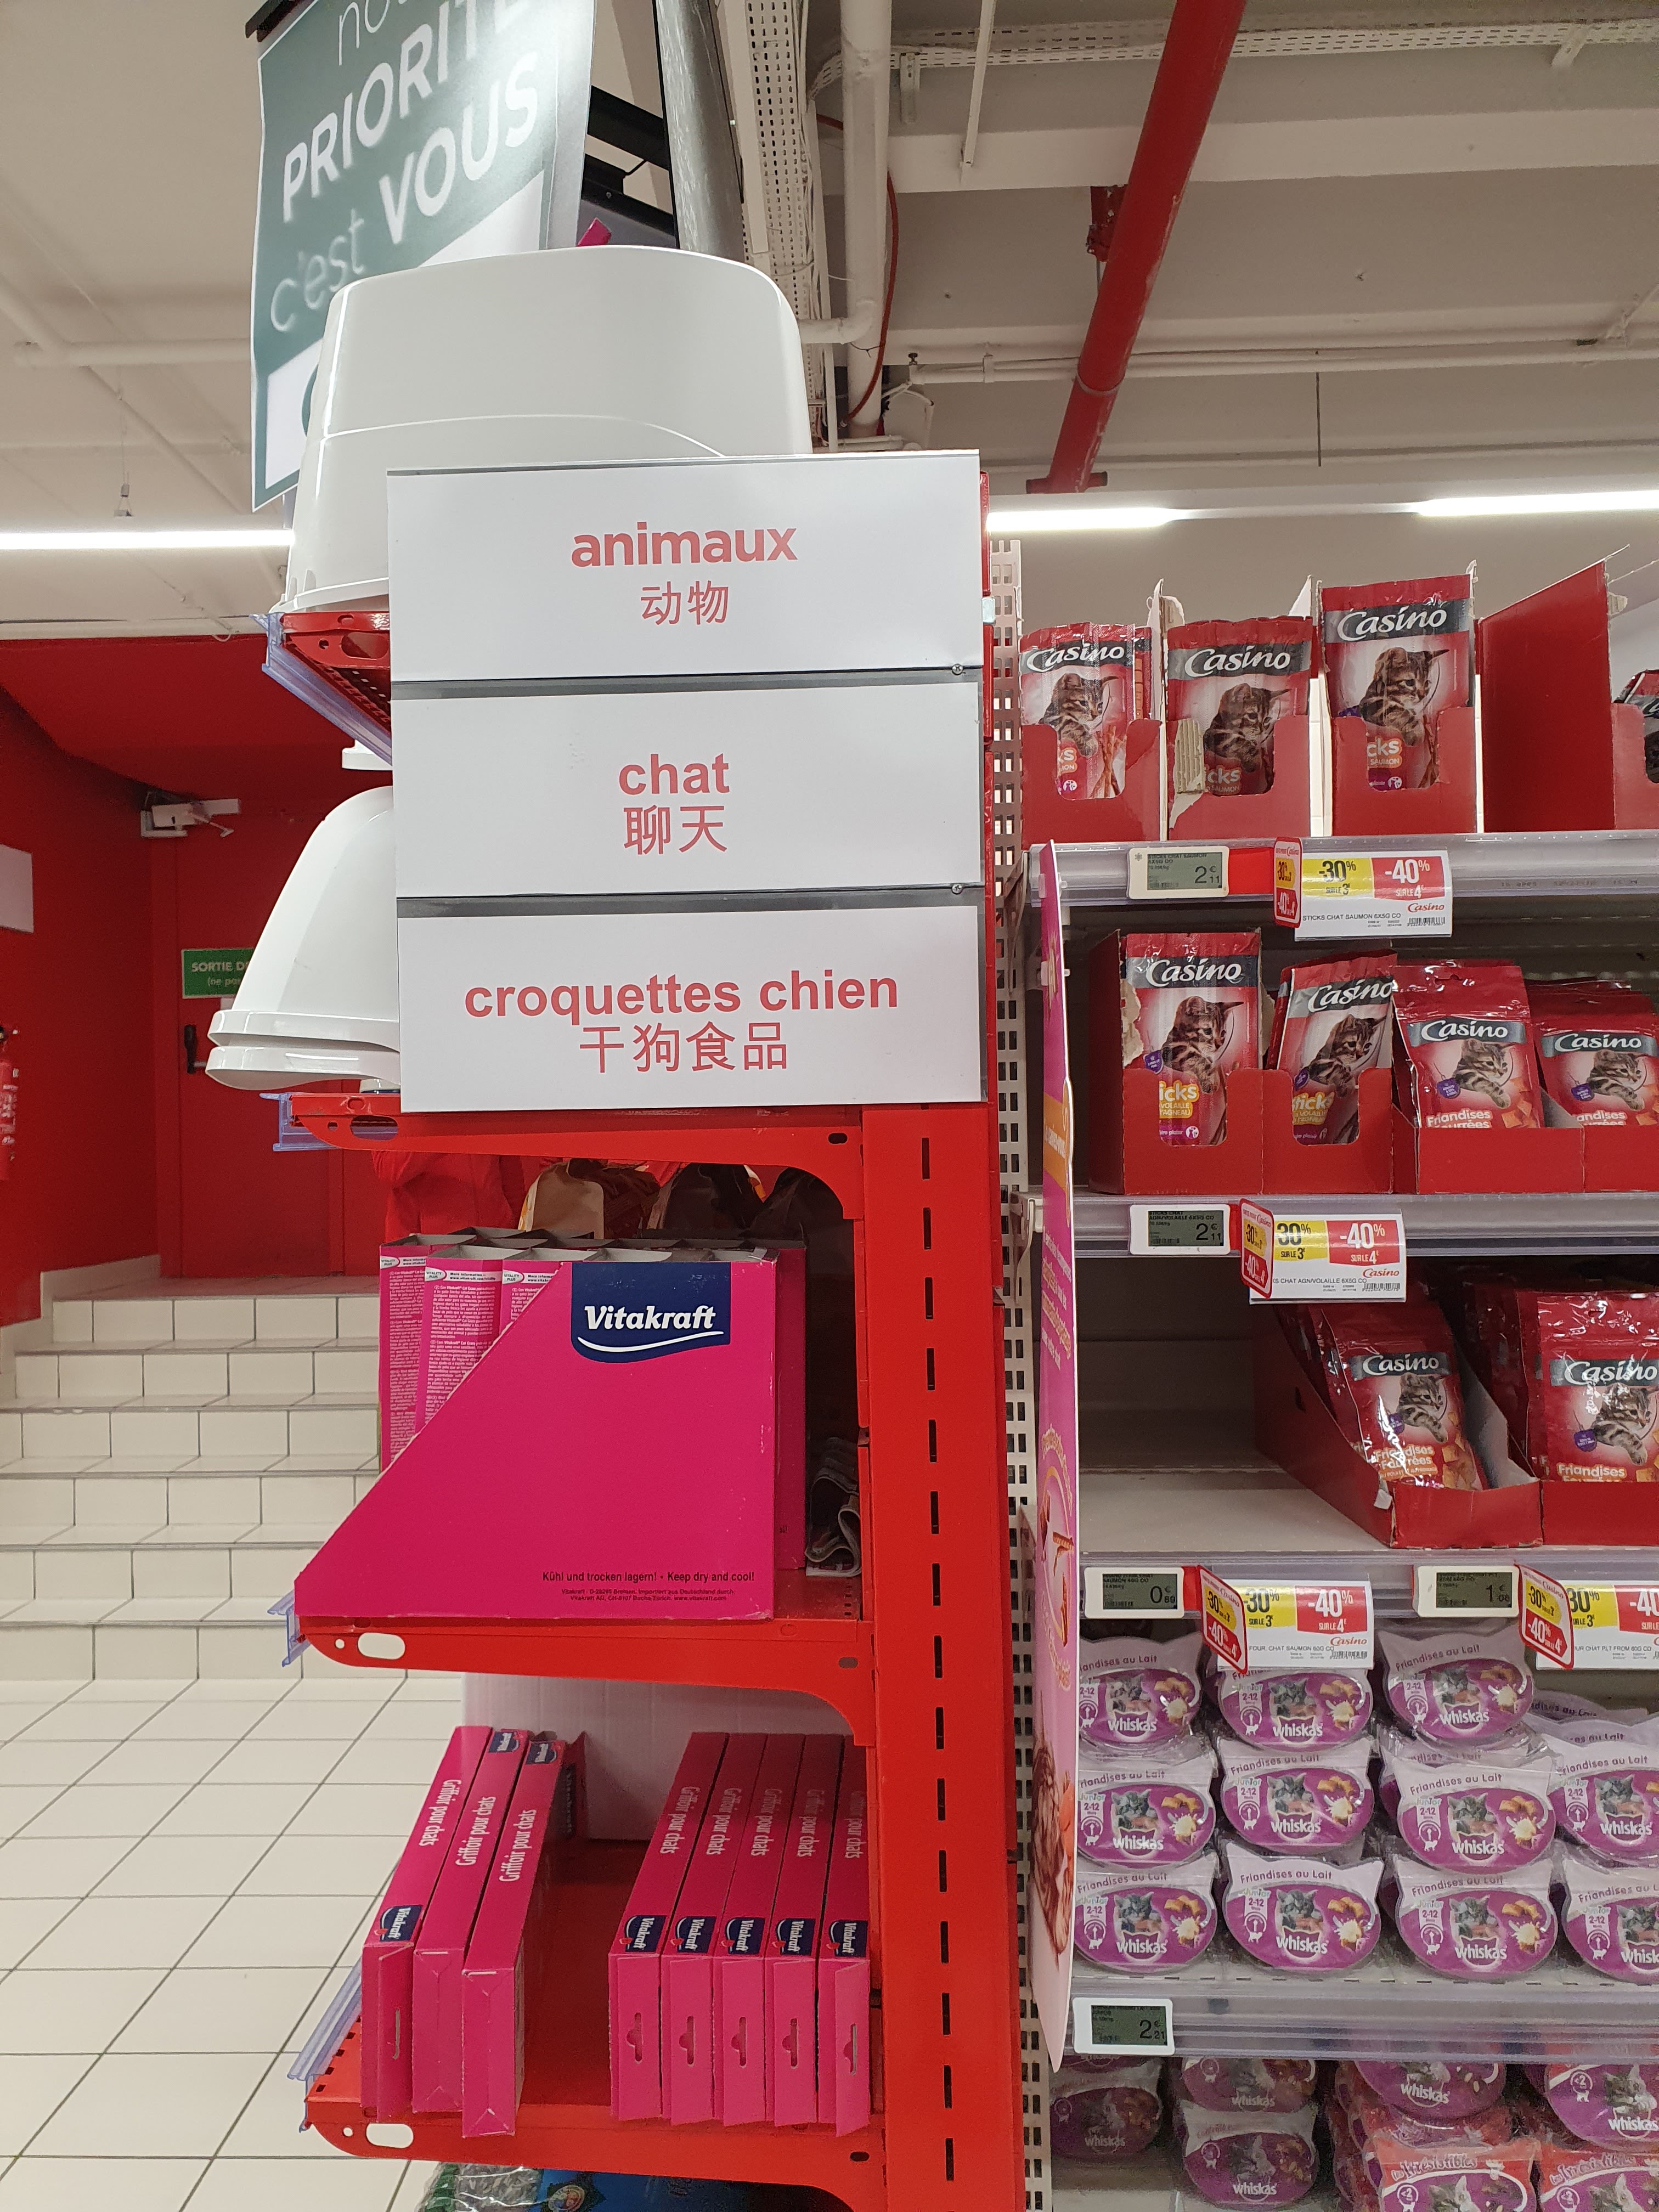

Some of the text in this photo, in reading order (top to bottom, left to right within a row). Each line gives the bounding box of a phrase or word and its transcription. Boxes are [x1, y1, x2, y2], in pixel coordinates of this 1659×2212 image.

[379, 51, 538, 245] VOUS
[270, 208, 364, 332] c'est
[572, 522, 798, 567] animaux
[641, 580, 729, 625] 动物
[1338, 605, 1448, 642] Casino
[1026, 642, 1125, 671] Casino
[1184, 645, 1291, 676] Casino
[618, 753, 730, 795] chat
[624, 805, 727, 855] 聊天
[1319, 860, 1356, 882] -30%
[1385, 859, 1430, 884] -40%
[1396, 888, 1405, 896] SUR
[1407, 902, 1444, 912] Casino
[192, 961, 233, 972] SORTIE
[1146, 958, 1242, 986] Casino
[465, 970, 898, 1027] croquettes chien
[1308, 977, 1393, 1013] Casino
[1420, 1019, 1508, 1042] Casino
[579, 1022, 788, 1073] 干狗食品
[1554, 1032, 1643, 1053] Casino
[1159, 1083, 1197, 1102] icks
[1427, 1109, 1491, 1124] Friandises
[1277, 1223, 1311, 1245] 30%
[1340, 1223, 1385, 1249] -40%
[1362, 1268, 1400, 1278] Casino
[585, 1305, 716, 1330] Vitakraft
[1362, 1353, 1440, 1375] Casino
[1565, 1360, 1658, 1384] Casino
[1558, 1464, 1625, 1477] Friandises
[543, 1572, 754, 1583] Kühl und trocken lagern! Keep dry and cool!
[1244, 1588, 1279, 1612] -30%
[1308, 1589, 1353, 1617] -40%
[1330, 1637, 1367, 1646] Casino
[1395, 1651, 1443, 1672] Friandises
[1108, 1717, 1157, 1731] whiskas
[1439, 1709, 1490, 1724] whiskas
[1273, 1723, 1323, 1737] whiskas
[1231, 1758, 1282, 1775] Friandises
[1628, 1755, 1647, 1764] Lait
[1410, 1778, 1462, 1795] Friandises
[1482, 1773, 1502, 1782] Lait
[1568, 1788, 1583, 1797] 2-12
[419, 1779, 462, 1847] Griffoir pour chats
[1420, 1807, 1436, 1815] 2-12
[455, 1797, 496, 1866] Griffoir pour chats
[659, 1813, 686, 1854] pour chats
[706, 1814, 731, 1855] pour chats
[751, 1815, 775, 1856] pour chats
[797, 1816, 820, 1857] pour chats
[1271, 1819, 1321, 1833] whiskas
[1600, 1820, 1652, 1835] whiskas
[499, 1809, 537, 1882] Griffoir pour chats
[844, 1818, 867, 1858] pour chats
[1113, 1835, 1164, 1850] whiskas
[1452, 1839, 1505, 1854] whiskas
[1077, 1876, 1128, 1893] Friandises
[1240, 1870, 1292, 1883] Friandises
[1313, 1870, 1332, 1880] Lait
[1412, 1879, 1464, 1897] Friandises
[1578, 1886, 1632, 1903] Friandises
[1249, 1898, 1264, 1907] 2-12
[387, 1907, 411, 1939] Vitakraft
[1422, 1910, 1438, 1918] 2-12
[1588, 1915, 1605, 1924] 2-12
[633, 1917, 655, 1949] Vitakraft
[685, 1918, 704, 1950] Vitakraft
[736, 1920, 754, 1951] Vitakraft
[788, 1921, 805, 1952] Vitakraft
[842, 1922, 857, 1953] Vitakraft
[1116, 1939, 1167, 1953] whiskas
[1276, 1935, 1329, 1954] whiskas
[1454, 1944, 1508, 1959] whiskas
[1401, 2083, 1451, 2104] whiskas
[1609, 2118, 1658, 2131] whiskas
[1232, 2182, 1277, 2196] whiskas
